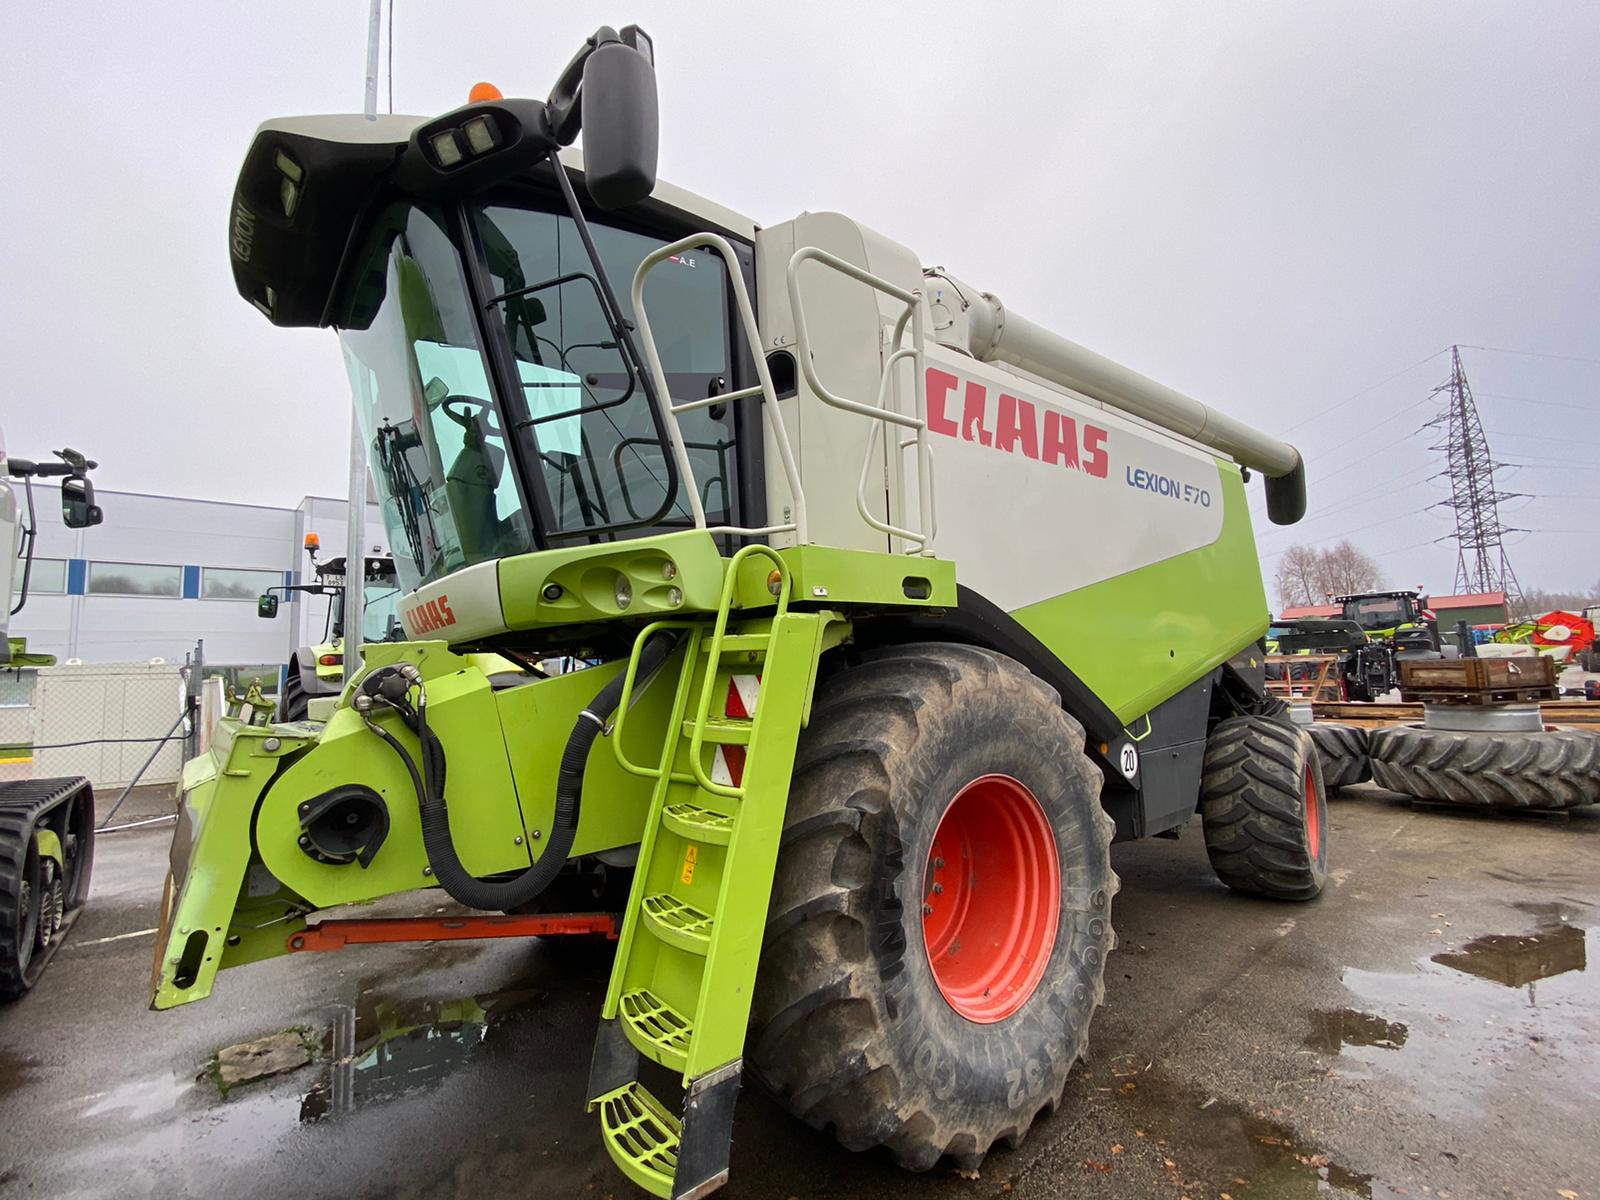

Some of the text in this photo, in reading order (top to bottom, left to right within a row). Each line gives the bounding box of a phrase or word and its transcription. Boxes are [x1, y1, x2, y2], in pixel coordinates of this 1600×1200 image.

[232, 203, 255, 262] LEXION
[925, 367, 1108, 479] CLAAS
[1126, 465, 1211, 508] LEXION 570
[1123, 750, 1135, 772] 20
